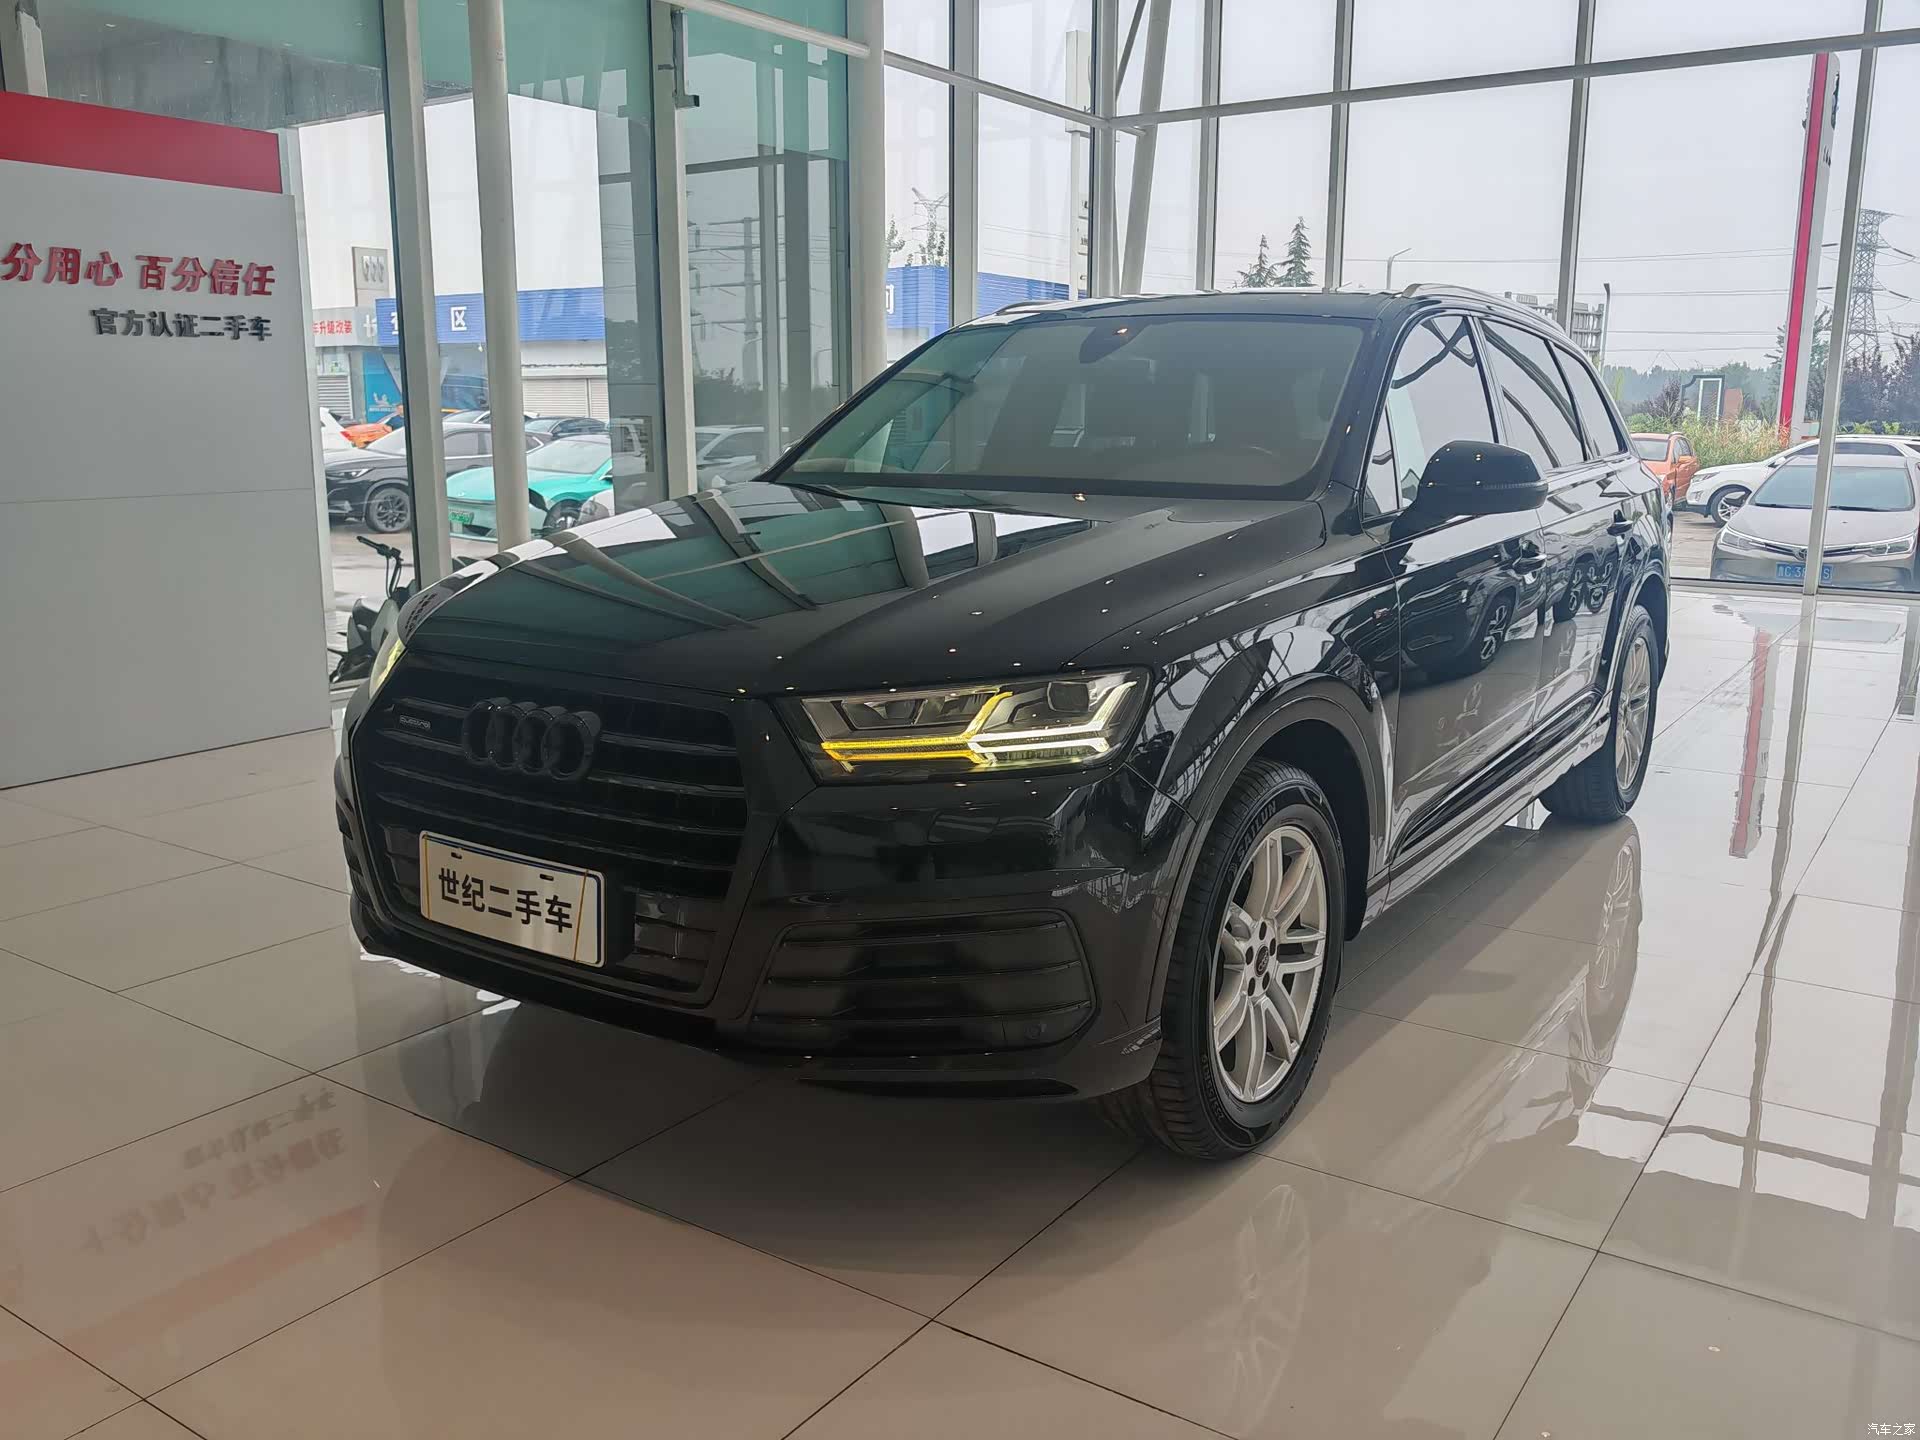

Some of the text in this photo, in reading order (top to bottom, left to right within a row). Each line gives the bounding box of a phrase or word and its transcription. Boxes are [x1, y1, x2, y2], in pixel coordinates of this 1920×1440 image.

[1, 242, 276, 296] 分用心 百分信任
[89, 308, 272, 341] 官方认证二手车
[451, 306, 467, 331] 区
[1236, 799, 1277, 860] SAILUN
[438, 867, 573, 933] 世纪二手车
